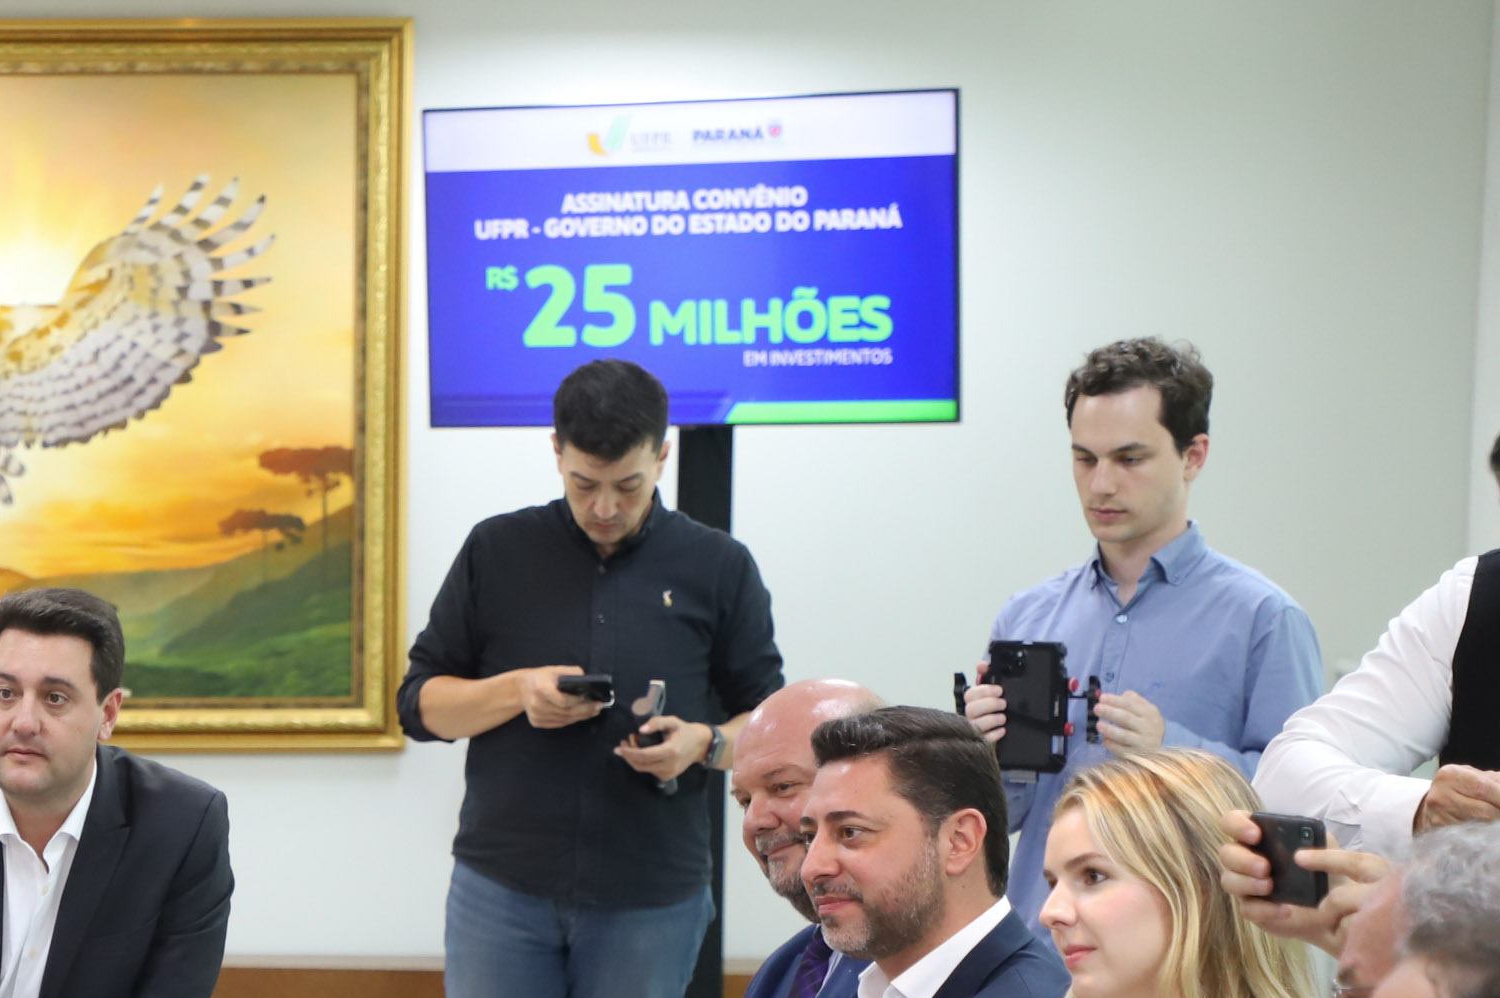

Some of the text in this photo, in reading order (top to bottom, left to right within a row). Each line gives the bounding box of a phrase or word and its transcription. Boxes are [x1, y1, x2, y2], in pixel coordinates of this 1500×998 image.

[692, 126, 764, 141] PARANÁ
[560, 184, 808, 214] ASSINATURA CONVÊNIO
[474, 218, 530, 240] UFPR
[543, 214, 648, 239] GOVERNO
[650, 213, 686, 236] DO
[688, 211, 772, 234] ESTADO
[774, 209, 810, 232] DO
[813, 202, 903, 231] PARANÁ
[486, 263, 894, 348] R$ 25 MILHÕES
[743, 348, 893, 367] EM INVESTIMENTOS
